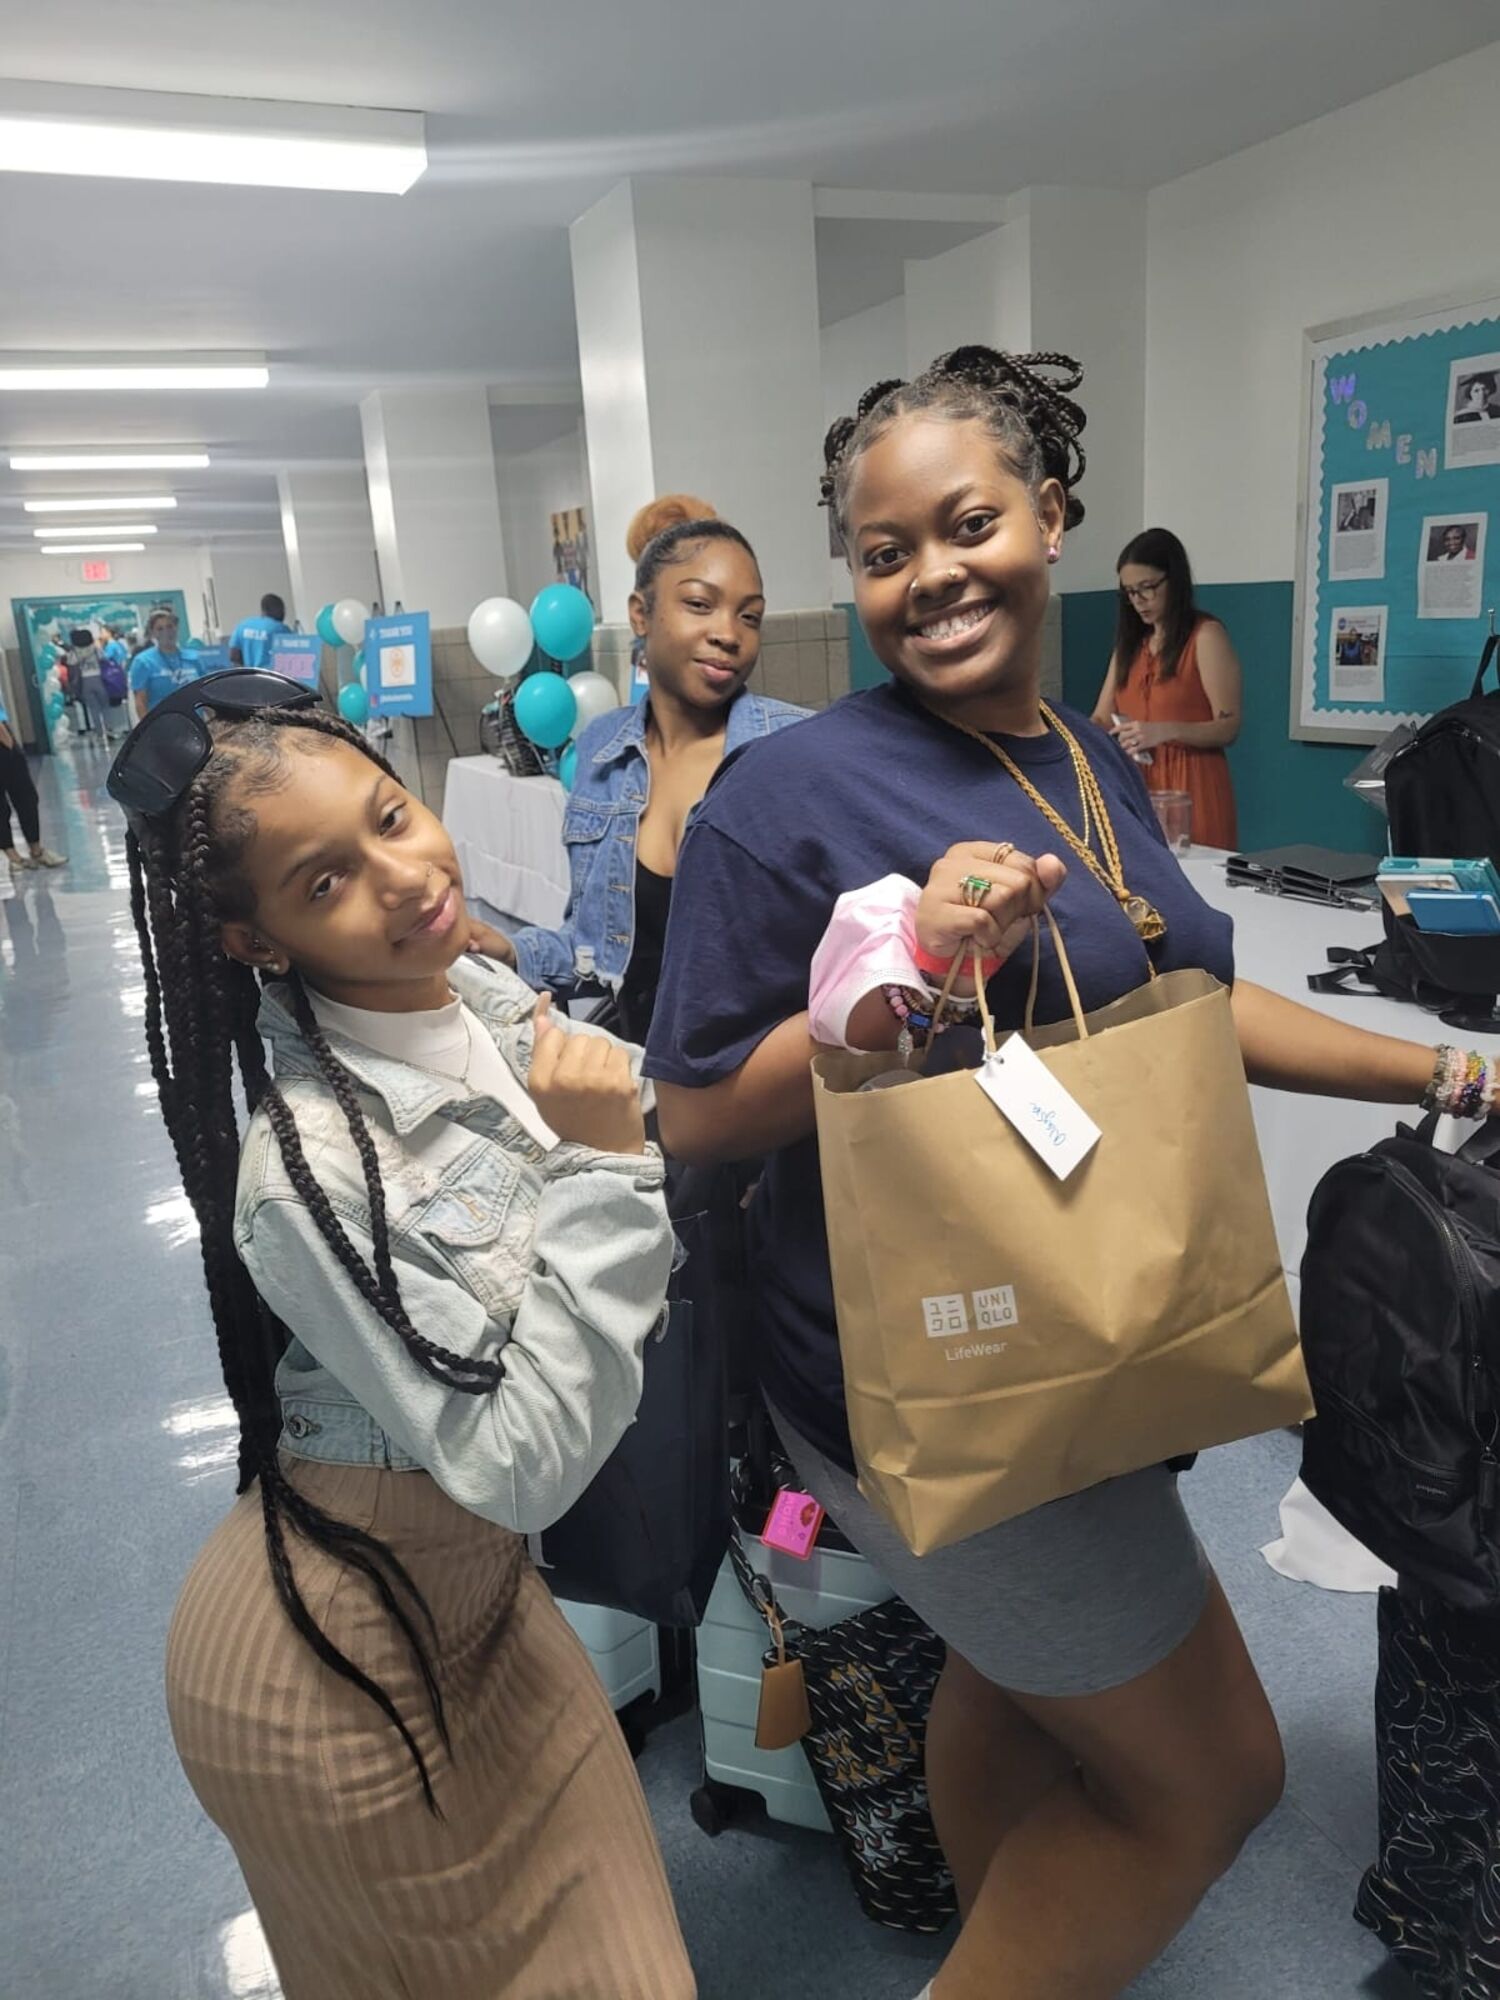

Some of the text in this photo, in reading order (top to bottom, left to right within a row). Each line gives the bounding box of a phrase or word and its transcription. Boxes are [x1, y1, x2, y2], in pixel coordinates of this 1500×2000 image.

[1329, 373, 1438, 480] WOMEN
[978, 1291, 1008, 1308] UNI
[981, 1307, 1012, 1325] QLO
[944, 1342, 1008, 1361] LifeWear
